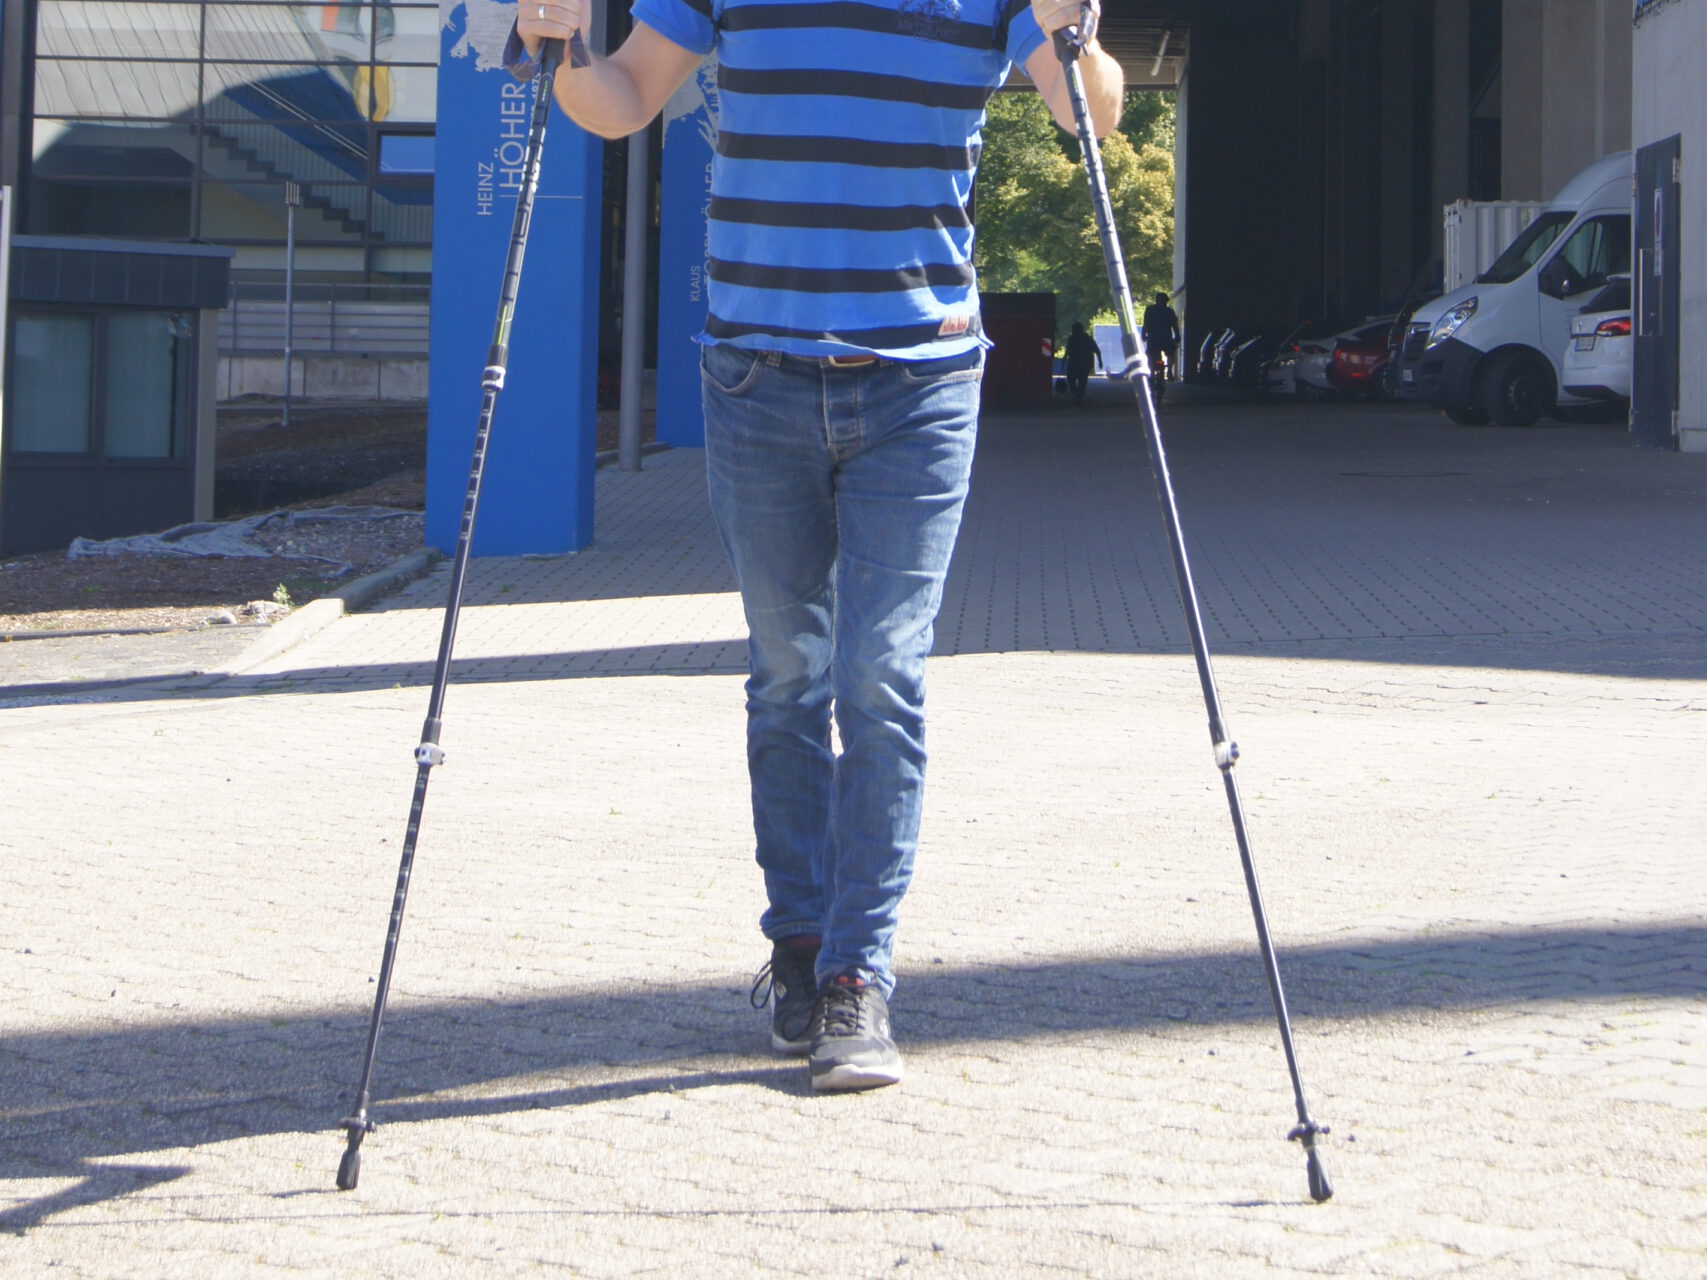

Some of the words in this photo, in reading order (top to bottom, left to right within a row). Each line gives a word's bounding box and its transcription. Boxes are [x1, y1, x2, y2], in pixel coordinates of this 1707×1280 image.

[493, 81, 526, 189] HÖHER
[477, 161, 494, 215] HEINZ
[690, 265, 701, 302] KLAUS
